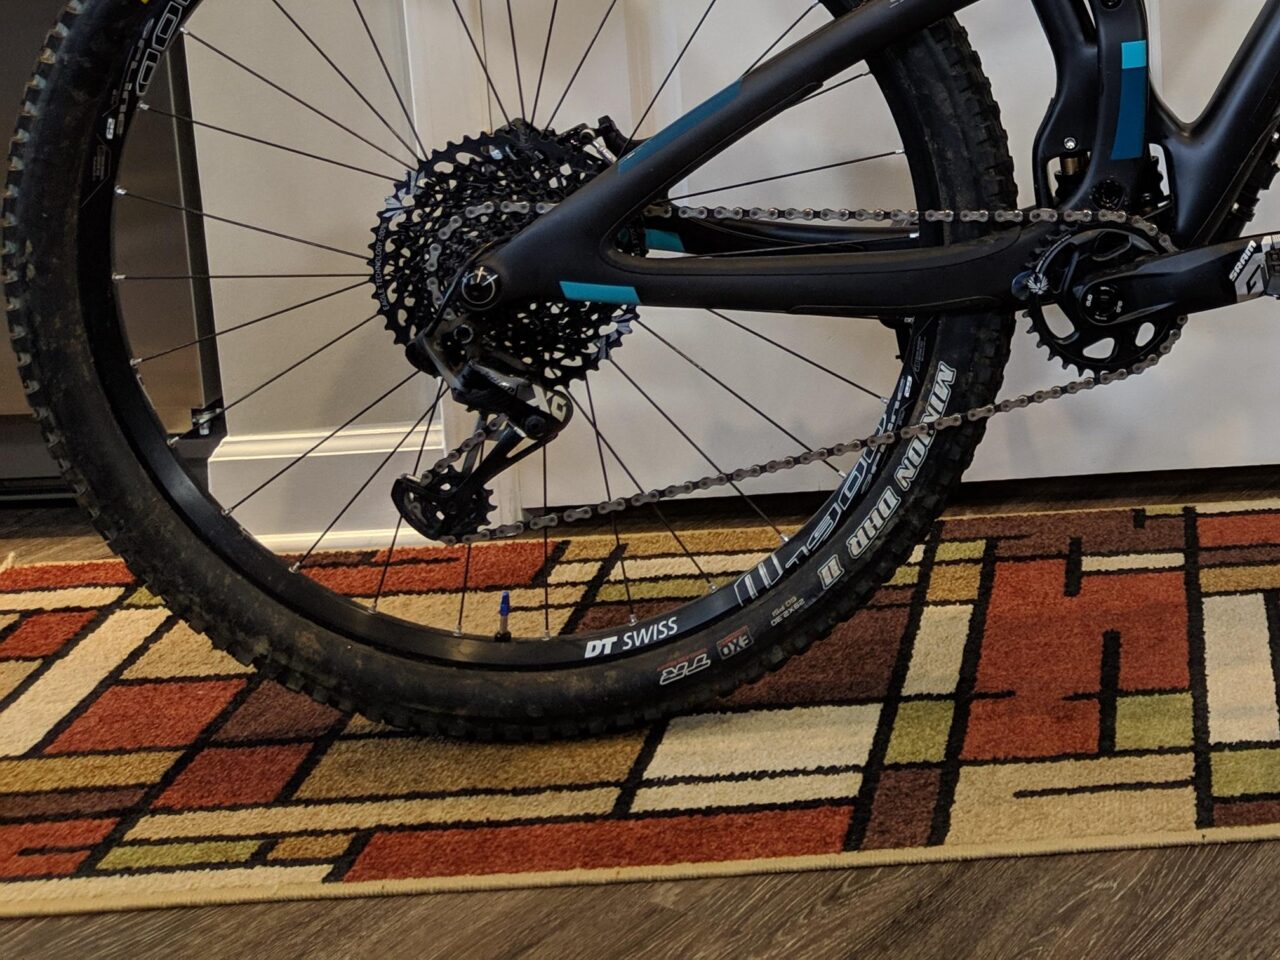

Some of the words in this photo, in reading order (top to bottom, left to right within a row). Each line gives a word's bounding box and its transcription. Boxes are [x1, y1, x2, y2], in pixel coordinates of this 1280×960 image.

[1229, 240, 1257, 282] SRAM
[846, 486, 902, 559] DHR
[584, 635, 618, 659] DT
[621, 617, 678, 651] SWISS
[720, 633, 753, 658] EXO
